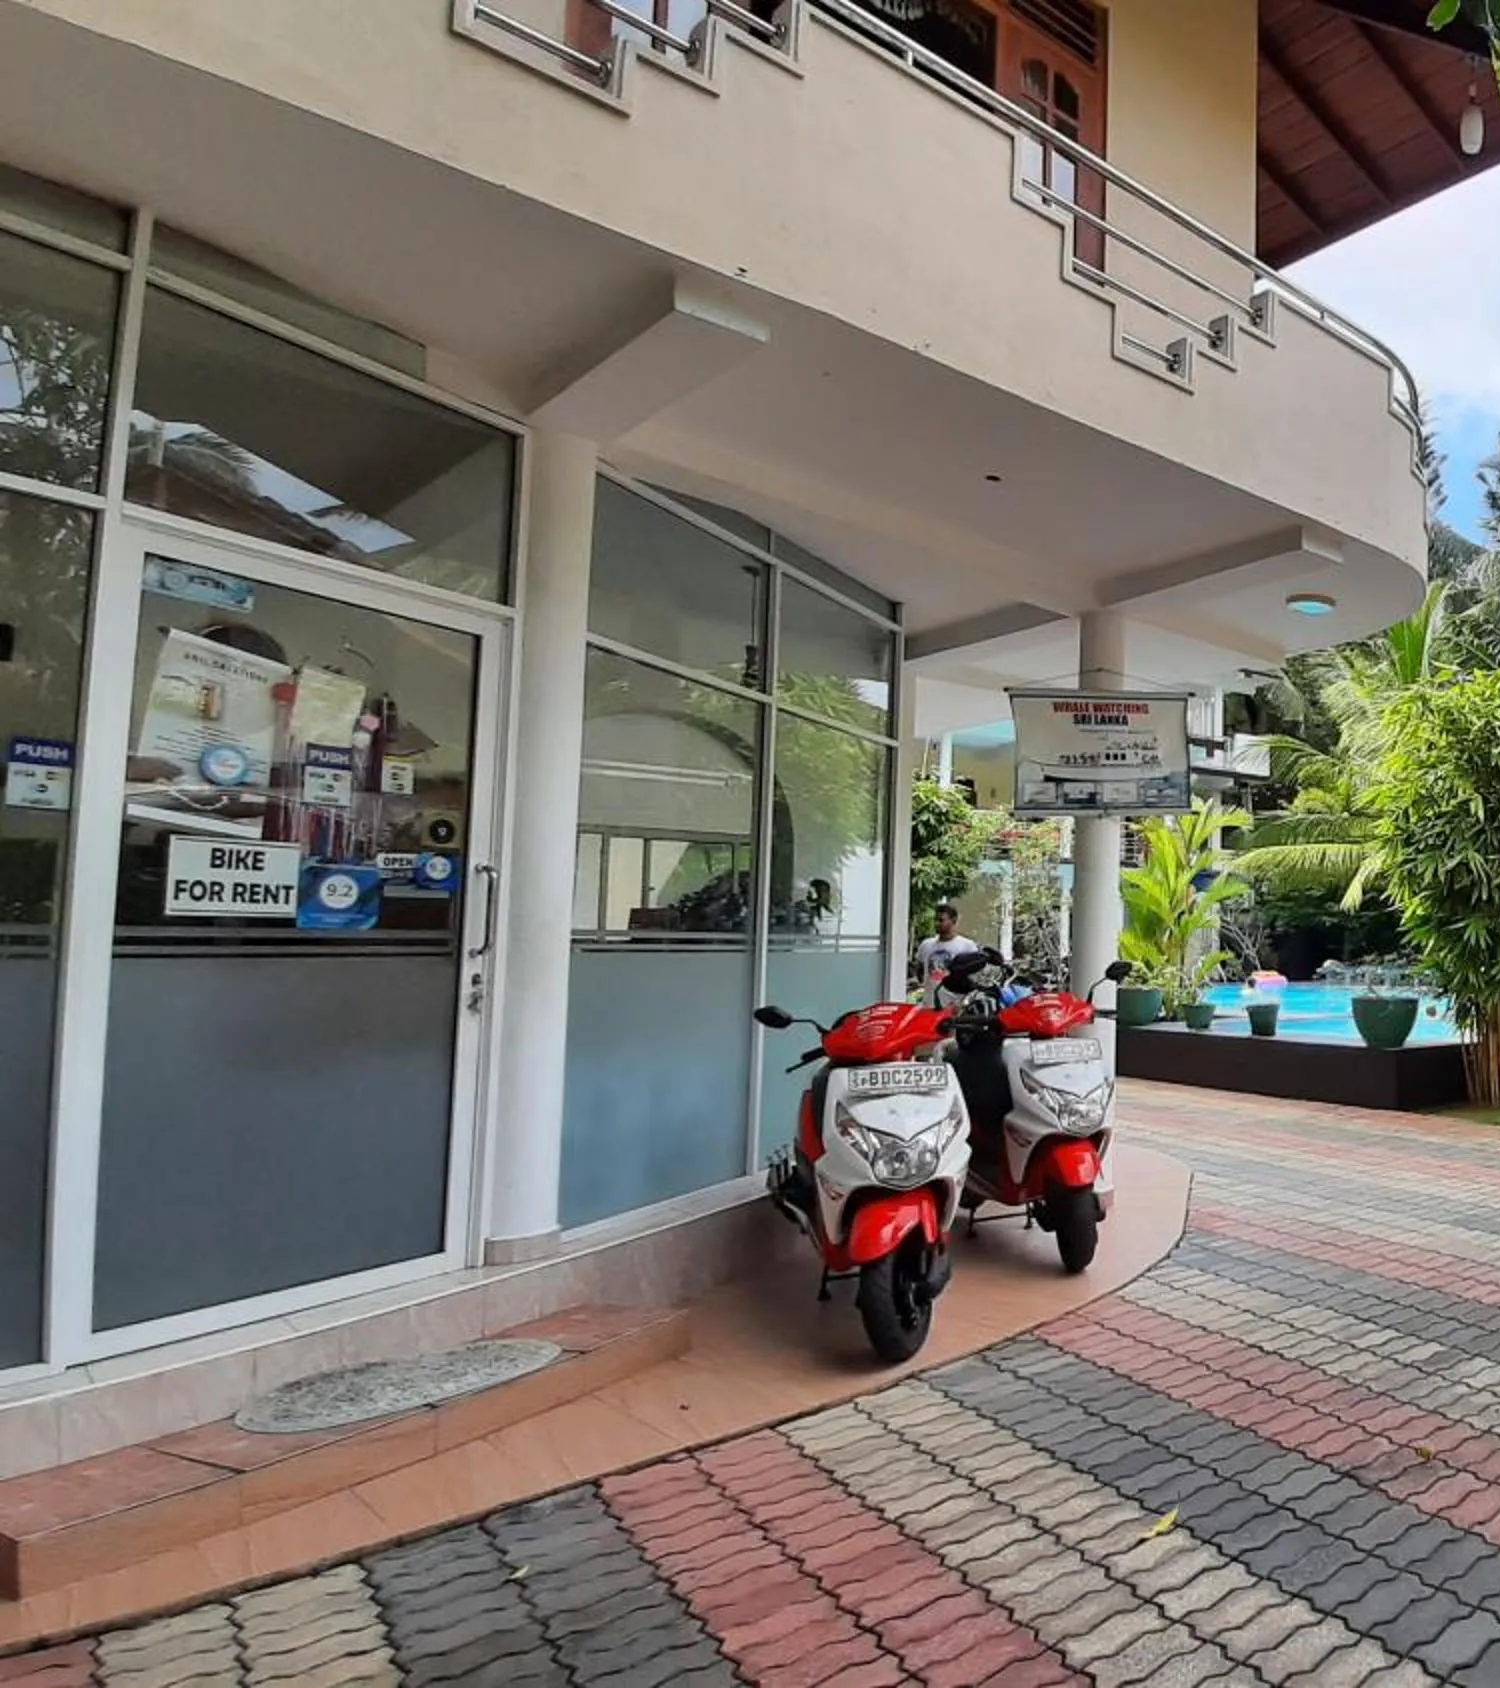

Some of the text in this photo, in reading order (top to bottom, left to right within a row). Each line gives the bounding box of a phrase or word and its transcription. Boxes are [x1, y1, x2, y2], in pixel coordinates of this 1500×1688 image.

[1092, 703, 1149, 714] WATCHING
[1073, 714, 1128, 726] SRI LANKA
[15, 743, 69, 760] PUSH
[308, 749, 350, 765] PUSH
[210, 847, 266, 871] BIKE
[383, 857, 413, 867] OPEN
[173, 879, 295, 905] FOR RENT
[326, 883, 353, 898] 9.2
